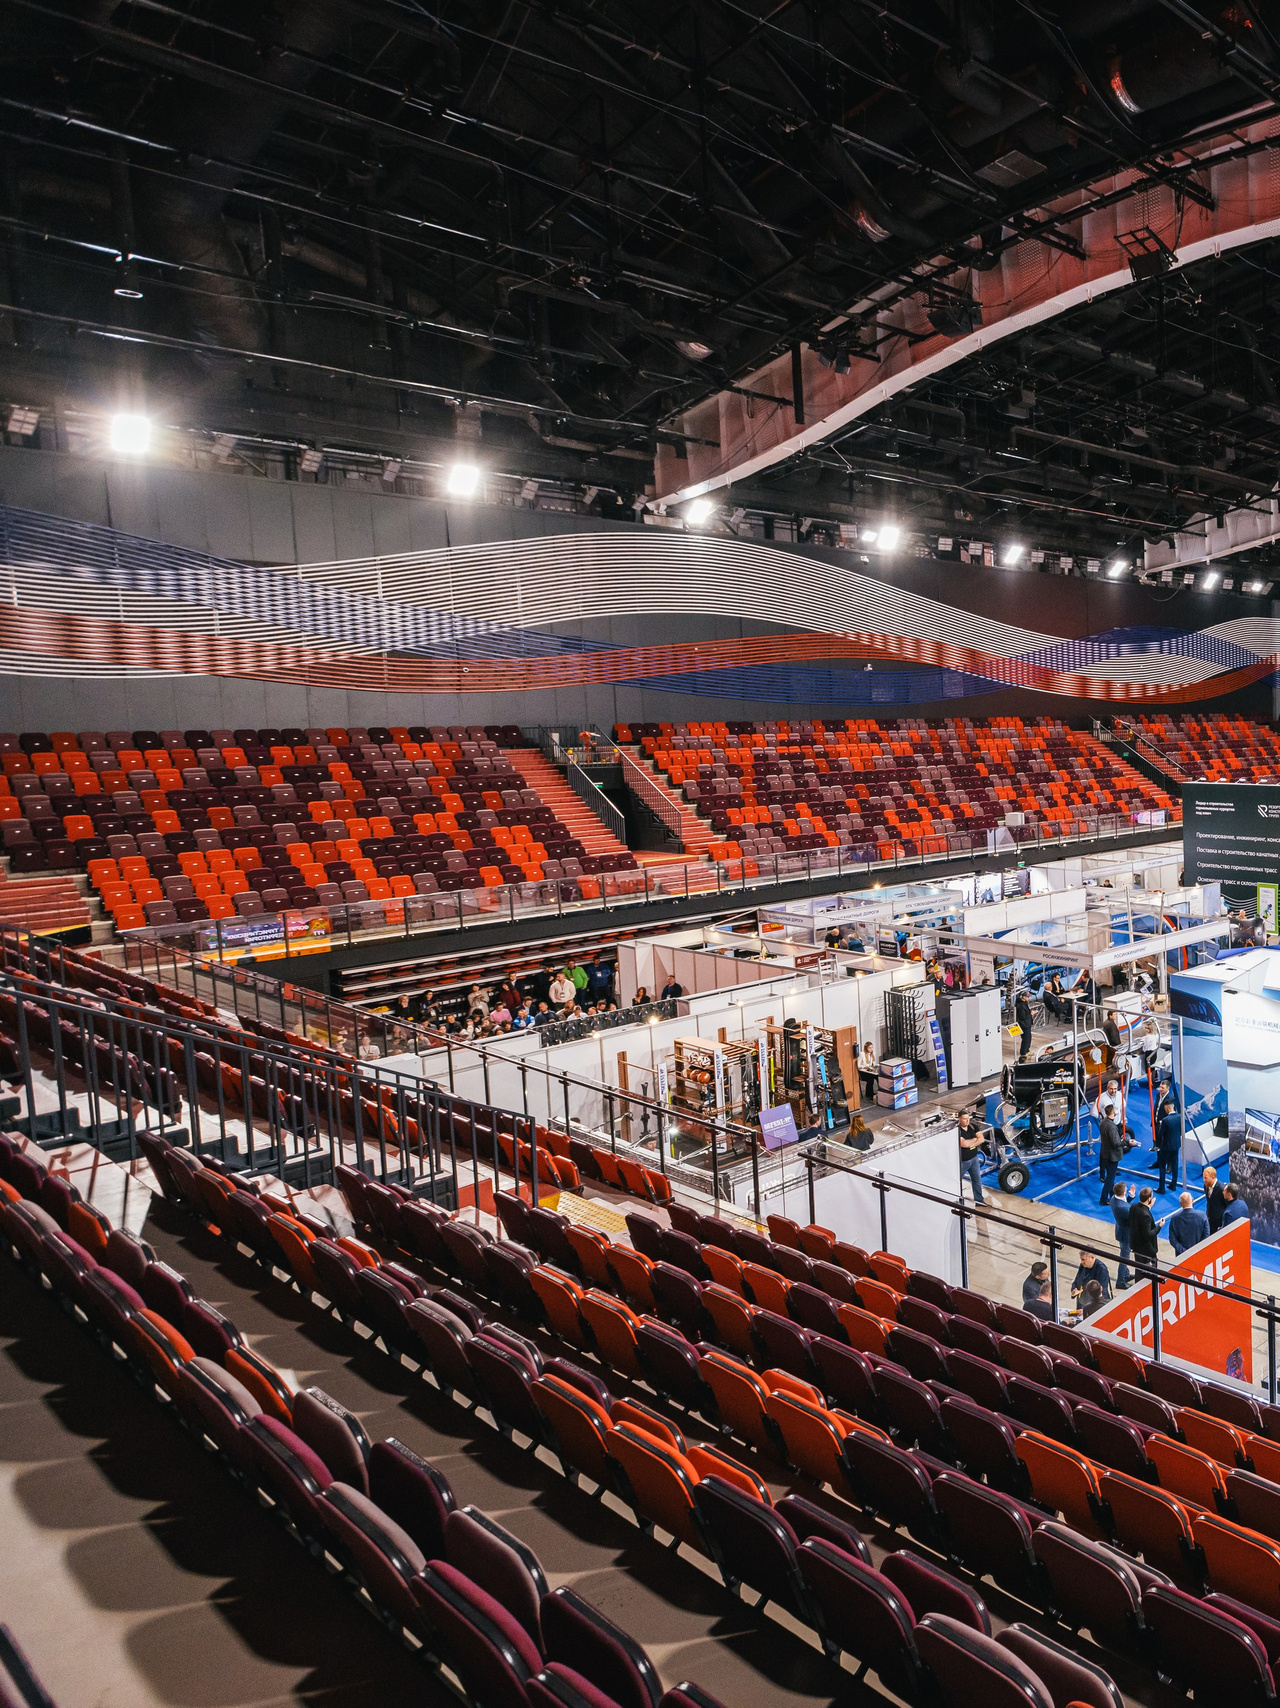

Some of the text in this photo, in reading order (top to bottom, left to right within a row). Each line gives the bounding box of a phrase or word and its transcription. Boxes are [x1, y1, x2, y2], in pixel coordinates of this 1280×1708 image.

[1196, 831, 1236, 841] Проектирование,
[1196, 846, 1217, 854] Поставка
[1221, 849, 1255, 857] строительство
[1196, 861, 1230, 869] Строительство
